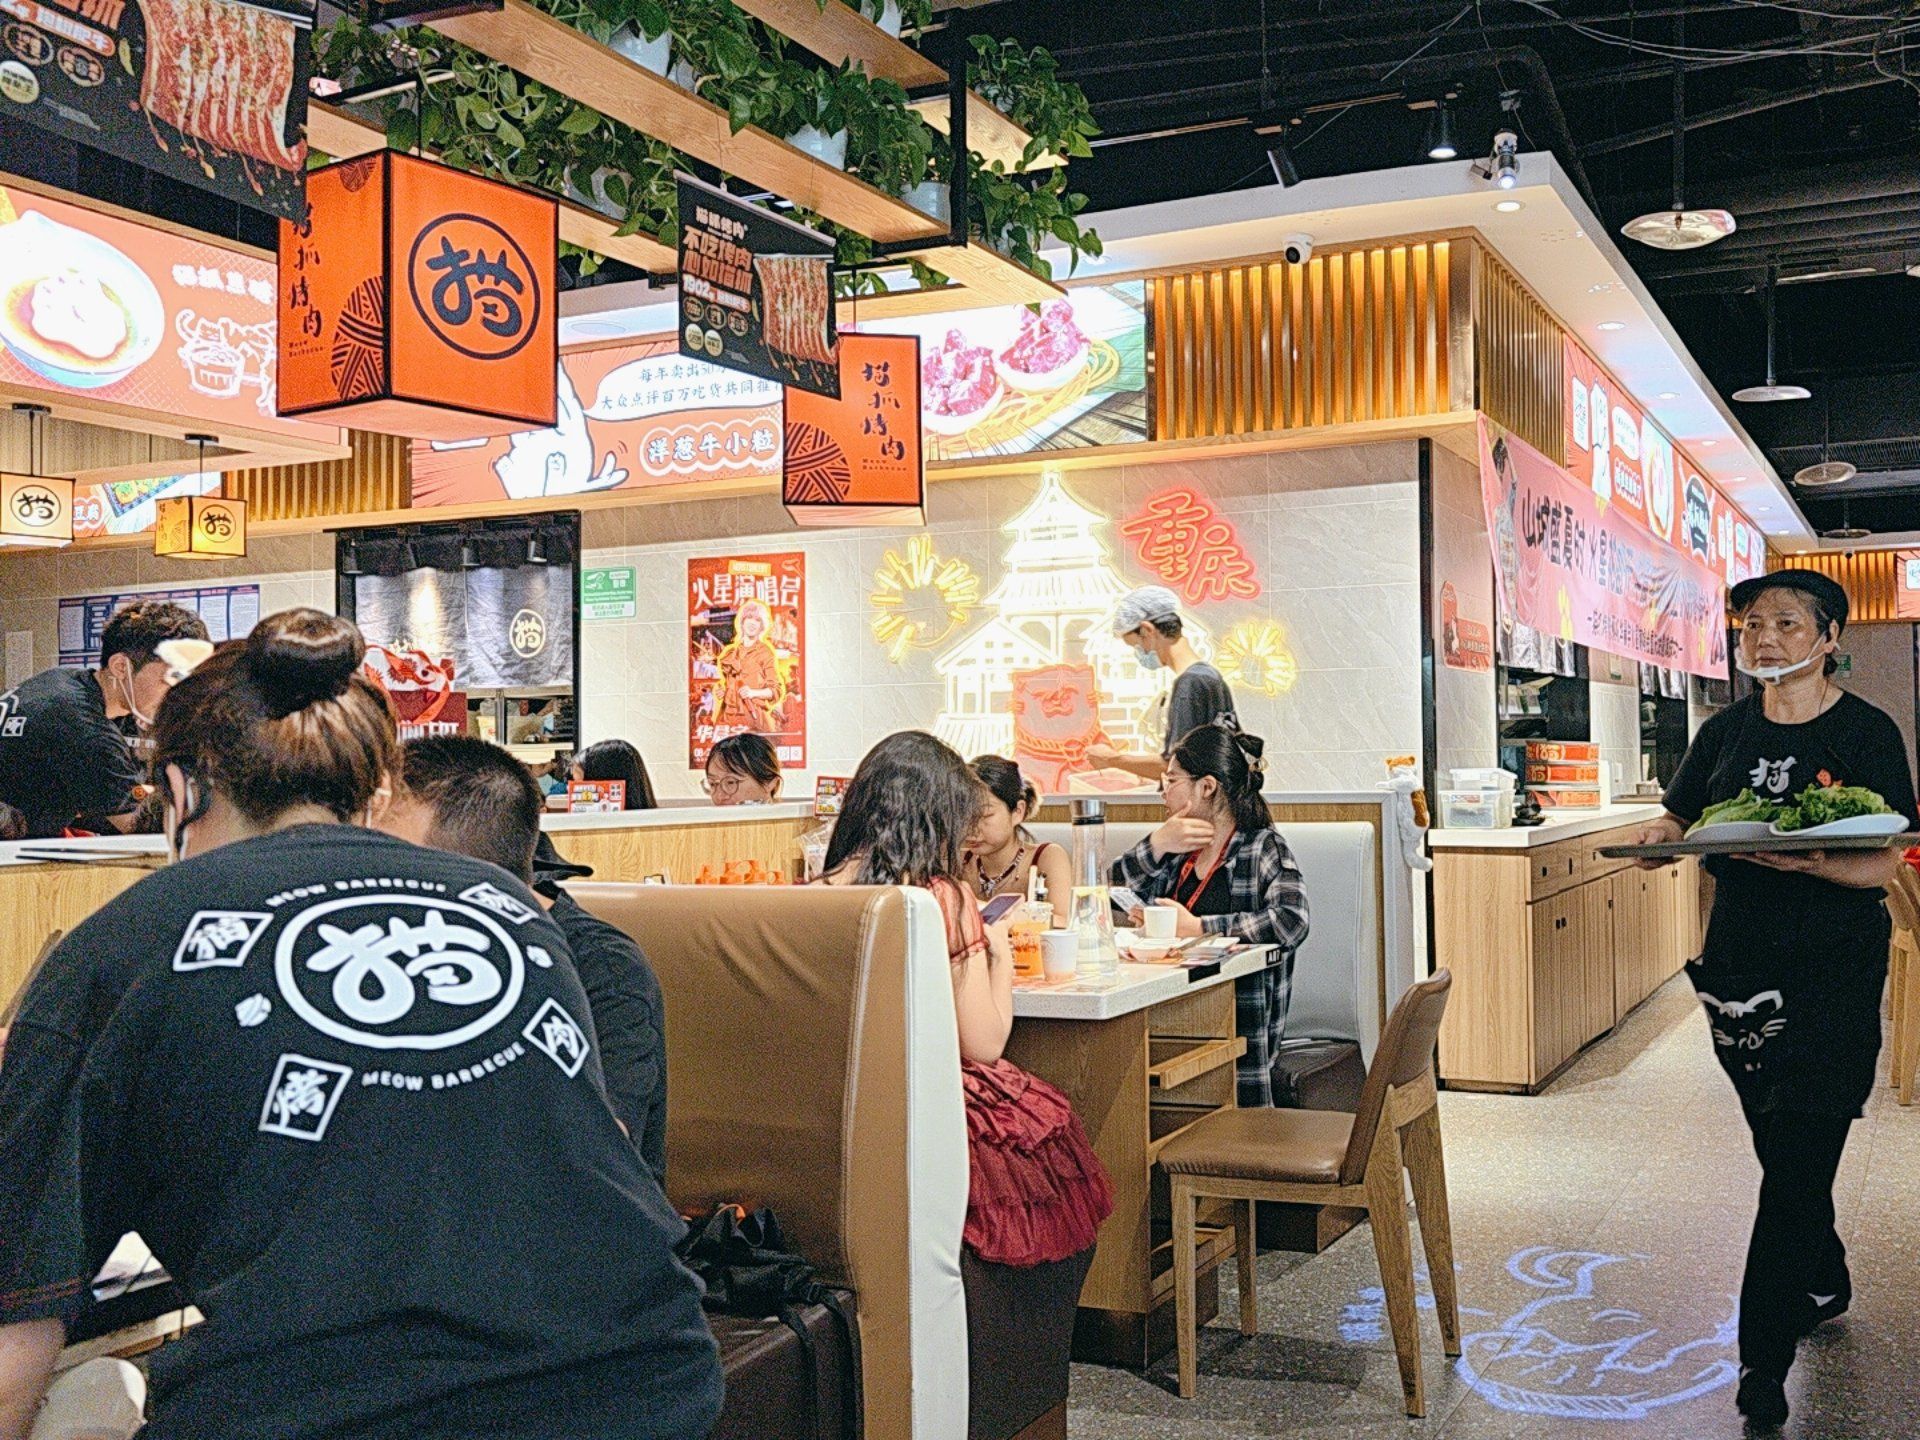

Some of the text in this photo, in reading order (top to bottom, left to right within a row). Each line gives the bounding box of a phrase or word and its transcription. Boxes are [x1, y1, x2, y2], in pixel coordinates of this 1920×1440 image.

[602, 380, 779, 410] 大众点评百万吃货共同推
[648, 427, 776, 464] 洋葱牛小粒
[693, 573, 801, 610] 火星演唱会
[265, 877, 446, 907] MEOW BARBECUE
[361, 1041, 526, 1091] MEOW BARBECUE
